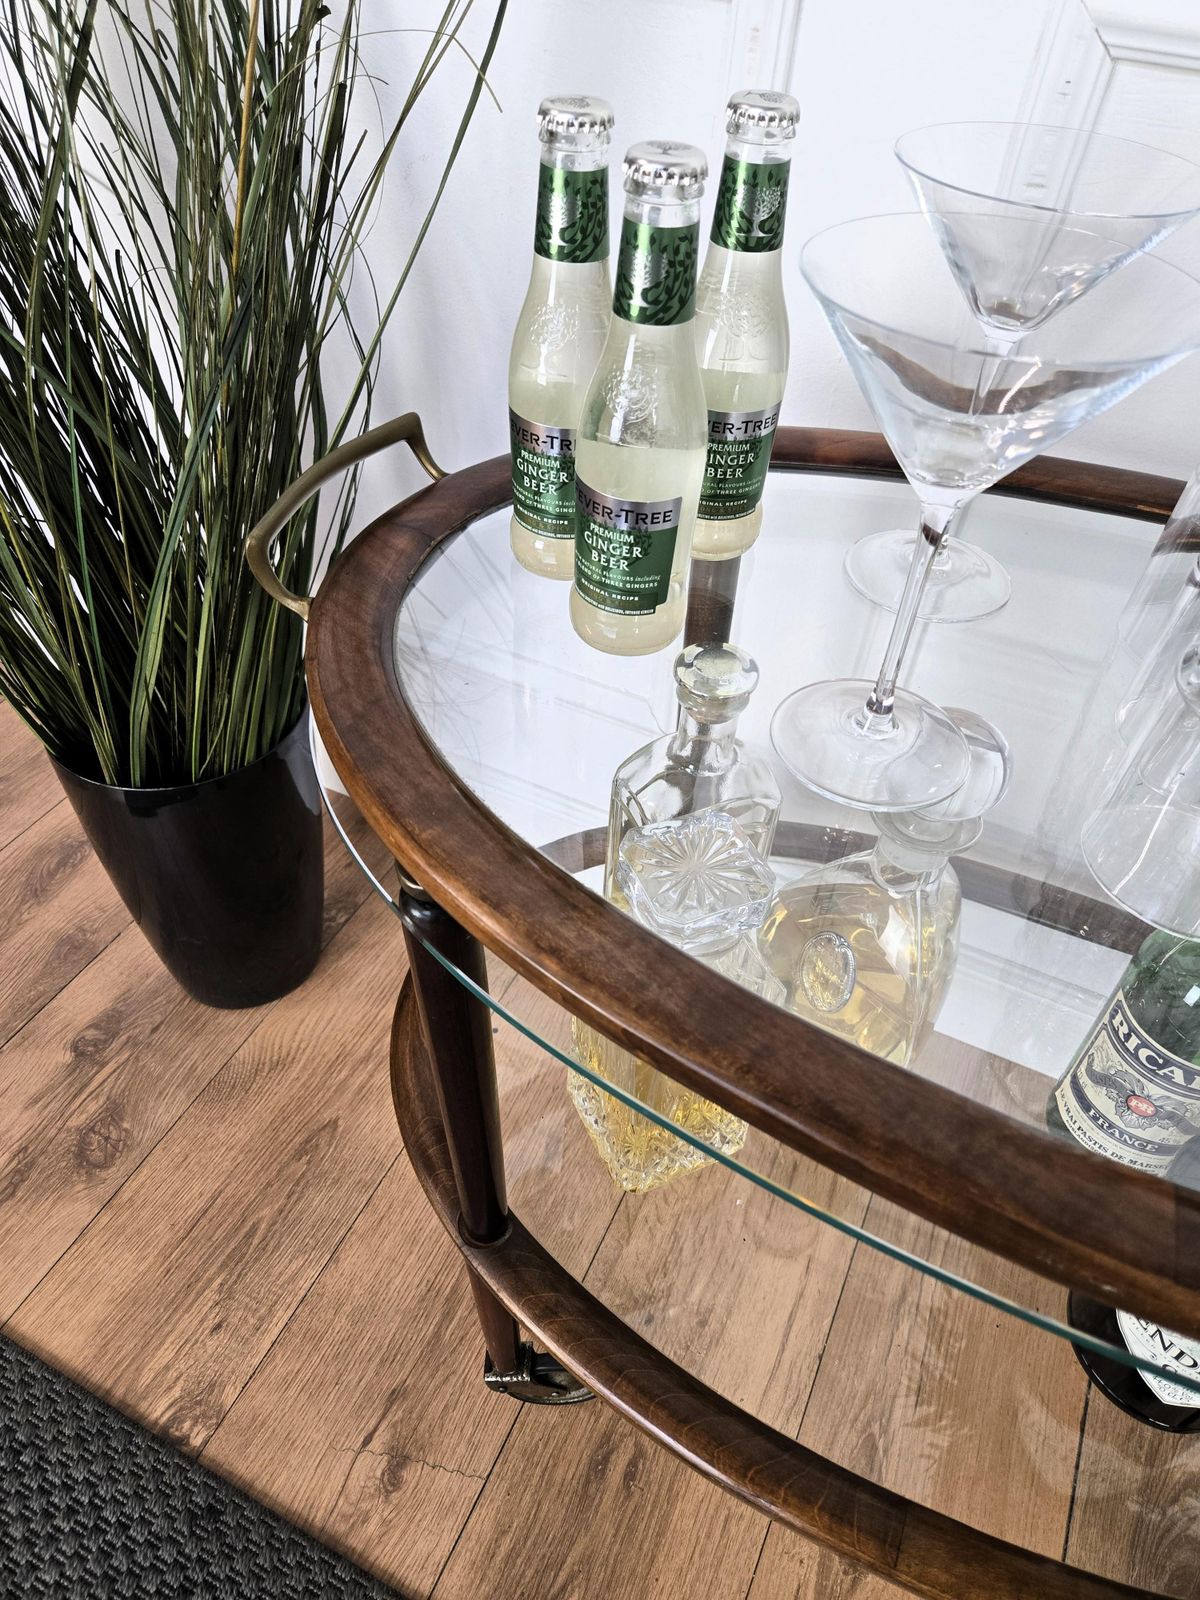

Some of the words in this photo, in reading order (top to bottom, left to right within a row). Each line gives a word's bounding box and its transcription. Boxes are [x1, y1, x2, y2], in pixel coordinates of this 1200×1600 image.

[511, 420, 576, 452] EVER-TR
[707, 442, 750, 452] PREMIUM
[521, 450, 560, 469] PREMIUM
[707, 453, 755, 466] INGER
[516, 458, 569, 483] GINGER
[706, 467, 743, 479] BEER
[523, 475, 557, 496] BEER
[543, 517, 569, 525] RECIPE
[590, 522, 634, 543] PREMIUM
[584, 530, 643, 558] GINGER
[591, 549, 630, 572] BEER
[625, 581, 658, 589] GINGERS
[611, 593, 639, 602] RECIPE
[1088, 1108, 1159, 1153] FRANCE
[1077, 1125, 1110, 1154] PASTIS
[1110, 1150, 1125, 1163] DE
